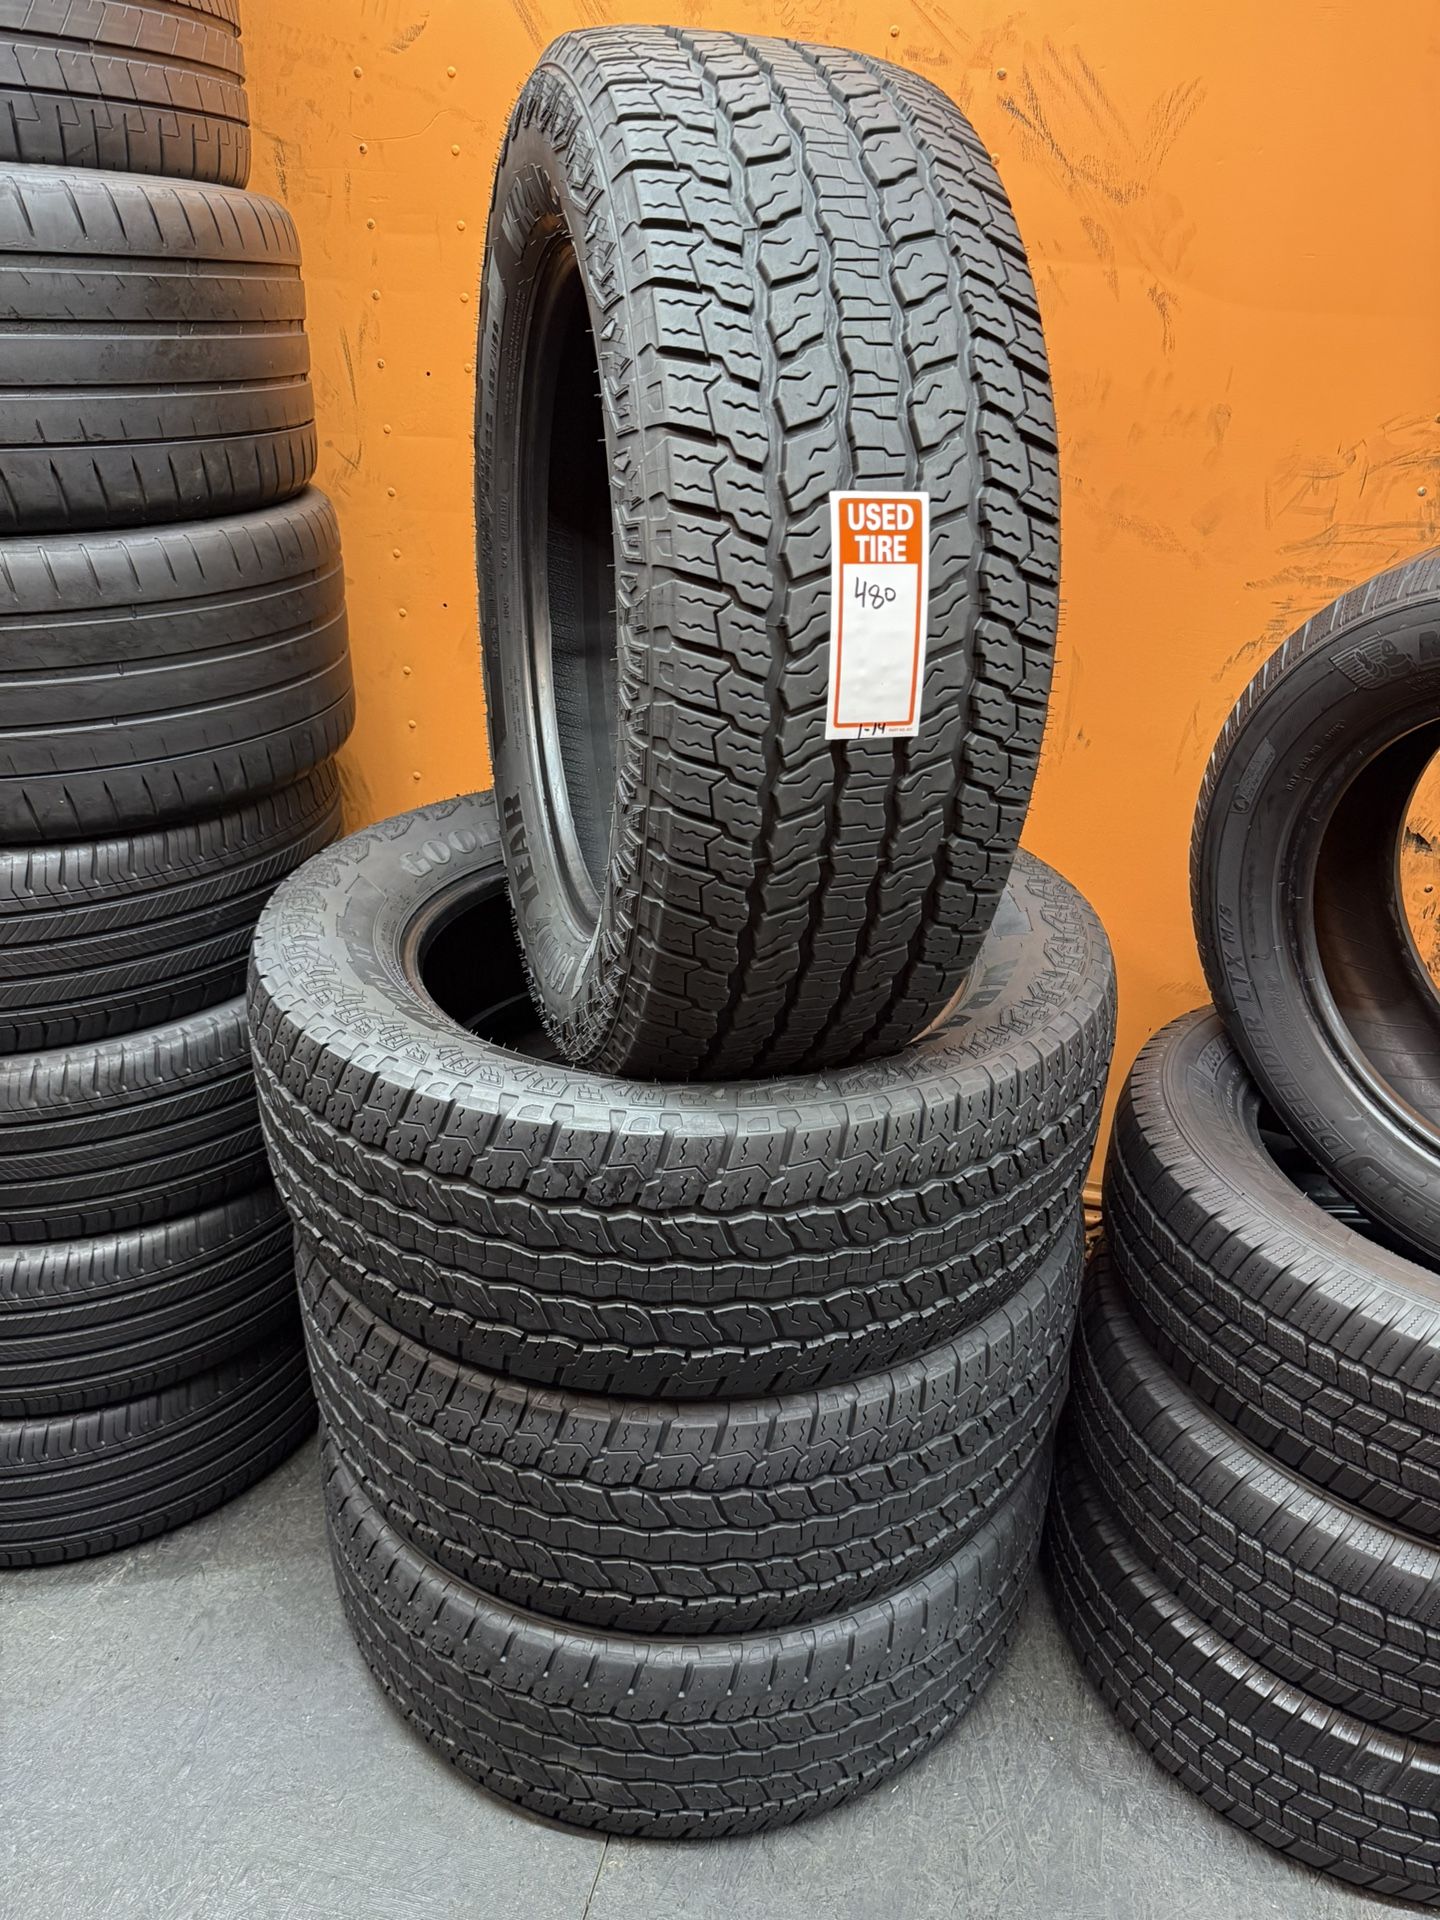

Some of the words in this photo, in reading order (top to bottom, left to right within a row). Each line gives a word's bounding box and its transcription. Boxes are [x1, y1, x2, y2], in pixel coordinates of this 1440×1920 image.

[848, 503, 914, 531] USED
[854, 535, 907, 562] TIRE
[854, 577, 896, 609] 480
[1218, 902, 1234, 945] M/S
[1226, 959, 1252, 1003] LTX
[1246, 1015, 1346, 1158] DEFENDER
